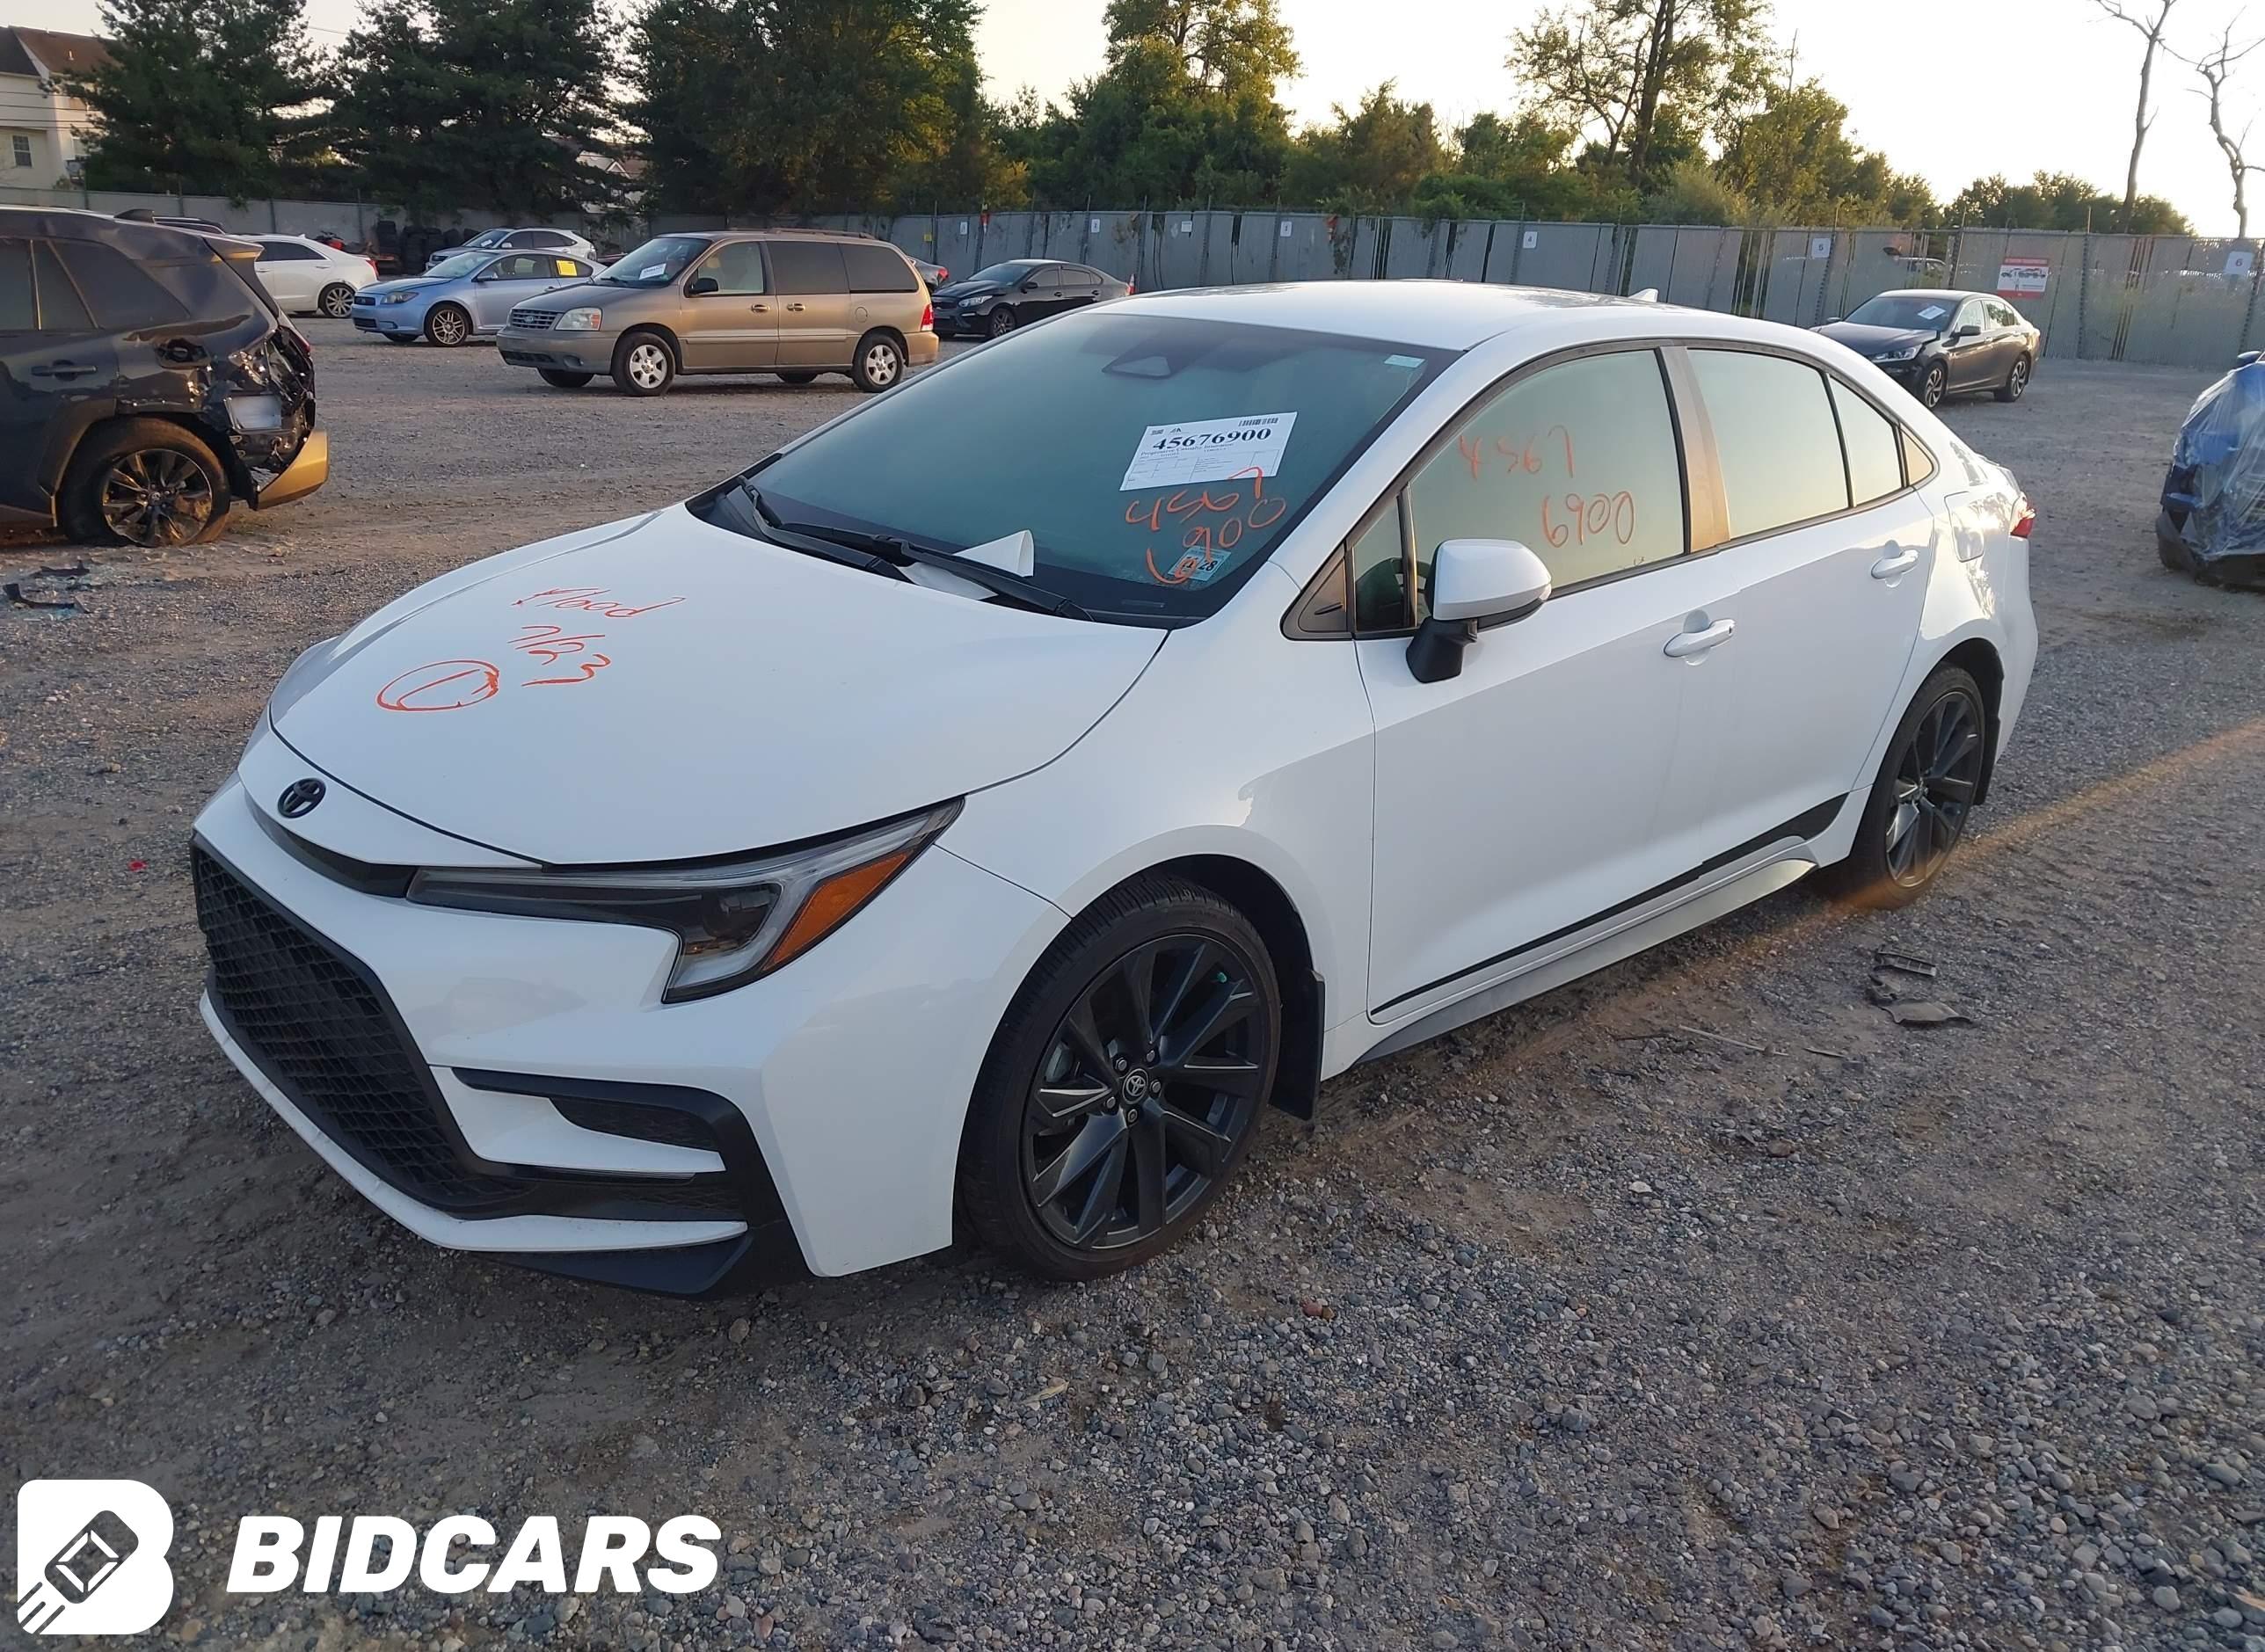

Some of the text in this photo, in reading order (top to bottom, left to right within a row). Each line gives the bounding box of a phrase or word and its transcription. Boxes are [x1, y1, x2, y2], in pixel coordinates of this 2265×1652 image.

[2235, 258, 2243, 267] 6
[1153, 428, 1271, 450] 45676900
[1457, 425, 1574, 482] 4567
[1542, 491, 1634, 548] 6900
[1198, 559, 1219, 571] 28
